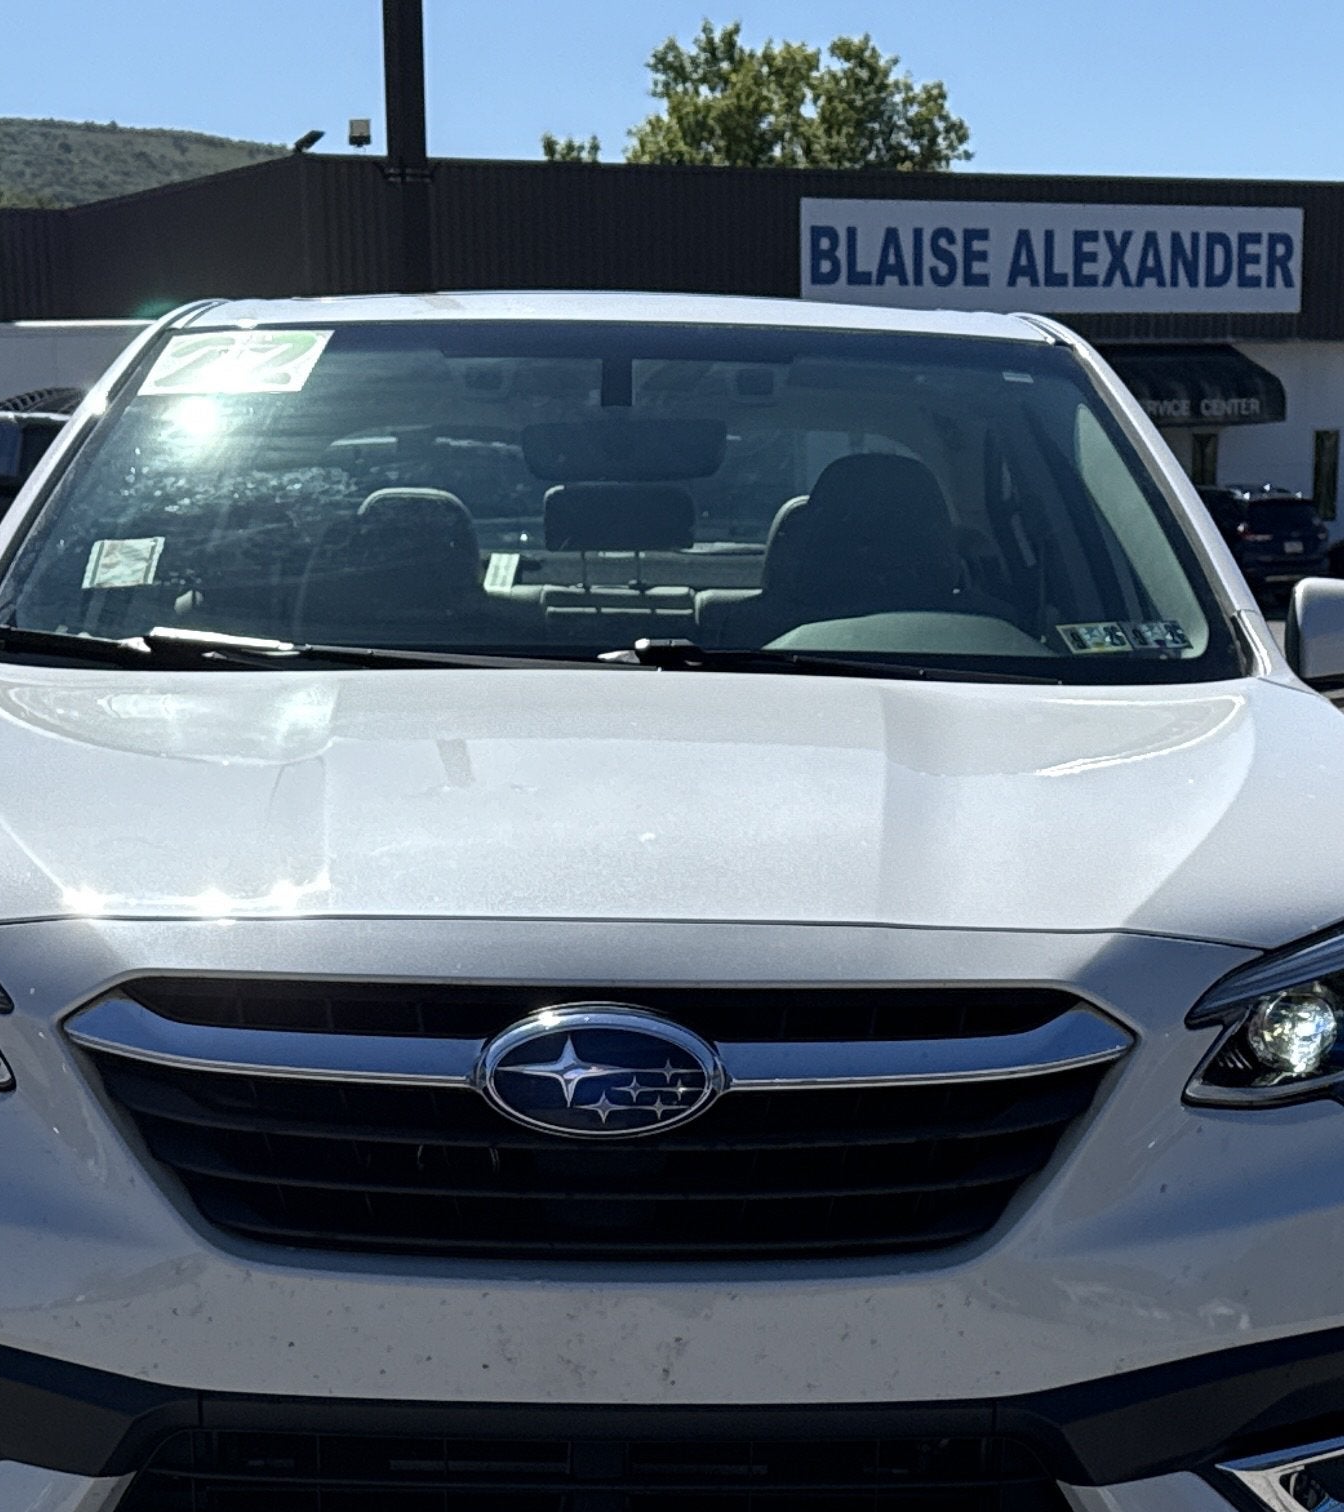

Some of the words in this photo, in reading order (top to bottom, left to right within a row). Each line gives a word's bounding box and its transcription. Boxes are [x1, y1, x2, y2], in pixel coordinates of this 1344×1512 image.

[810, 225, 990, 287] BLAISE
[1007, 228, 1294, 288] ALEXANDER
[1142, 398, 1191, 416] RVICE
[1200, 397, 1261, 416] CENTER
